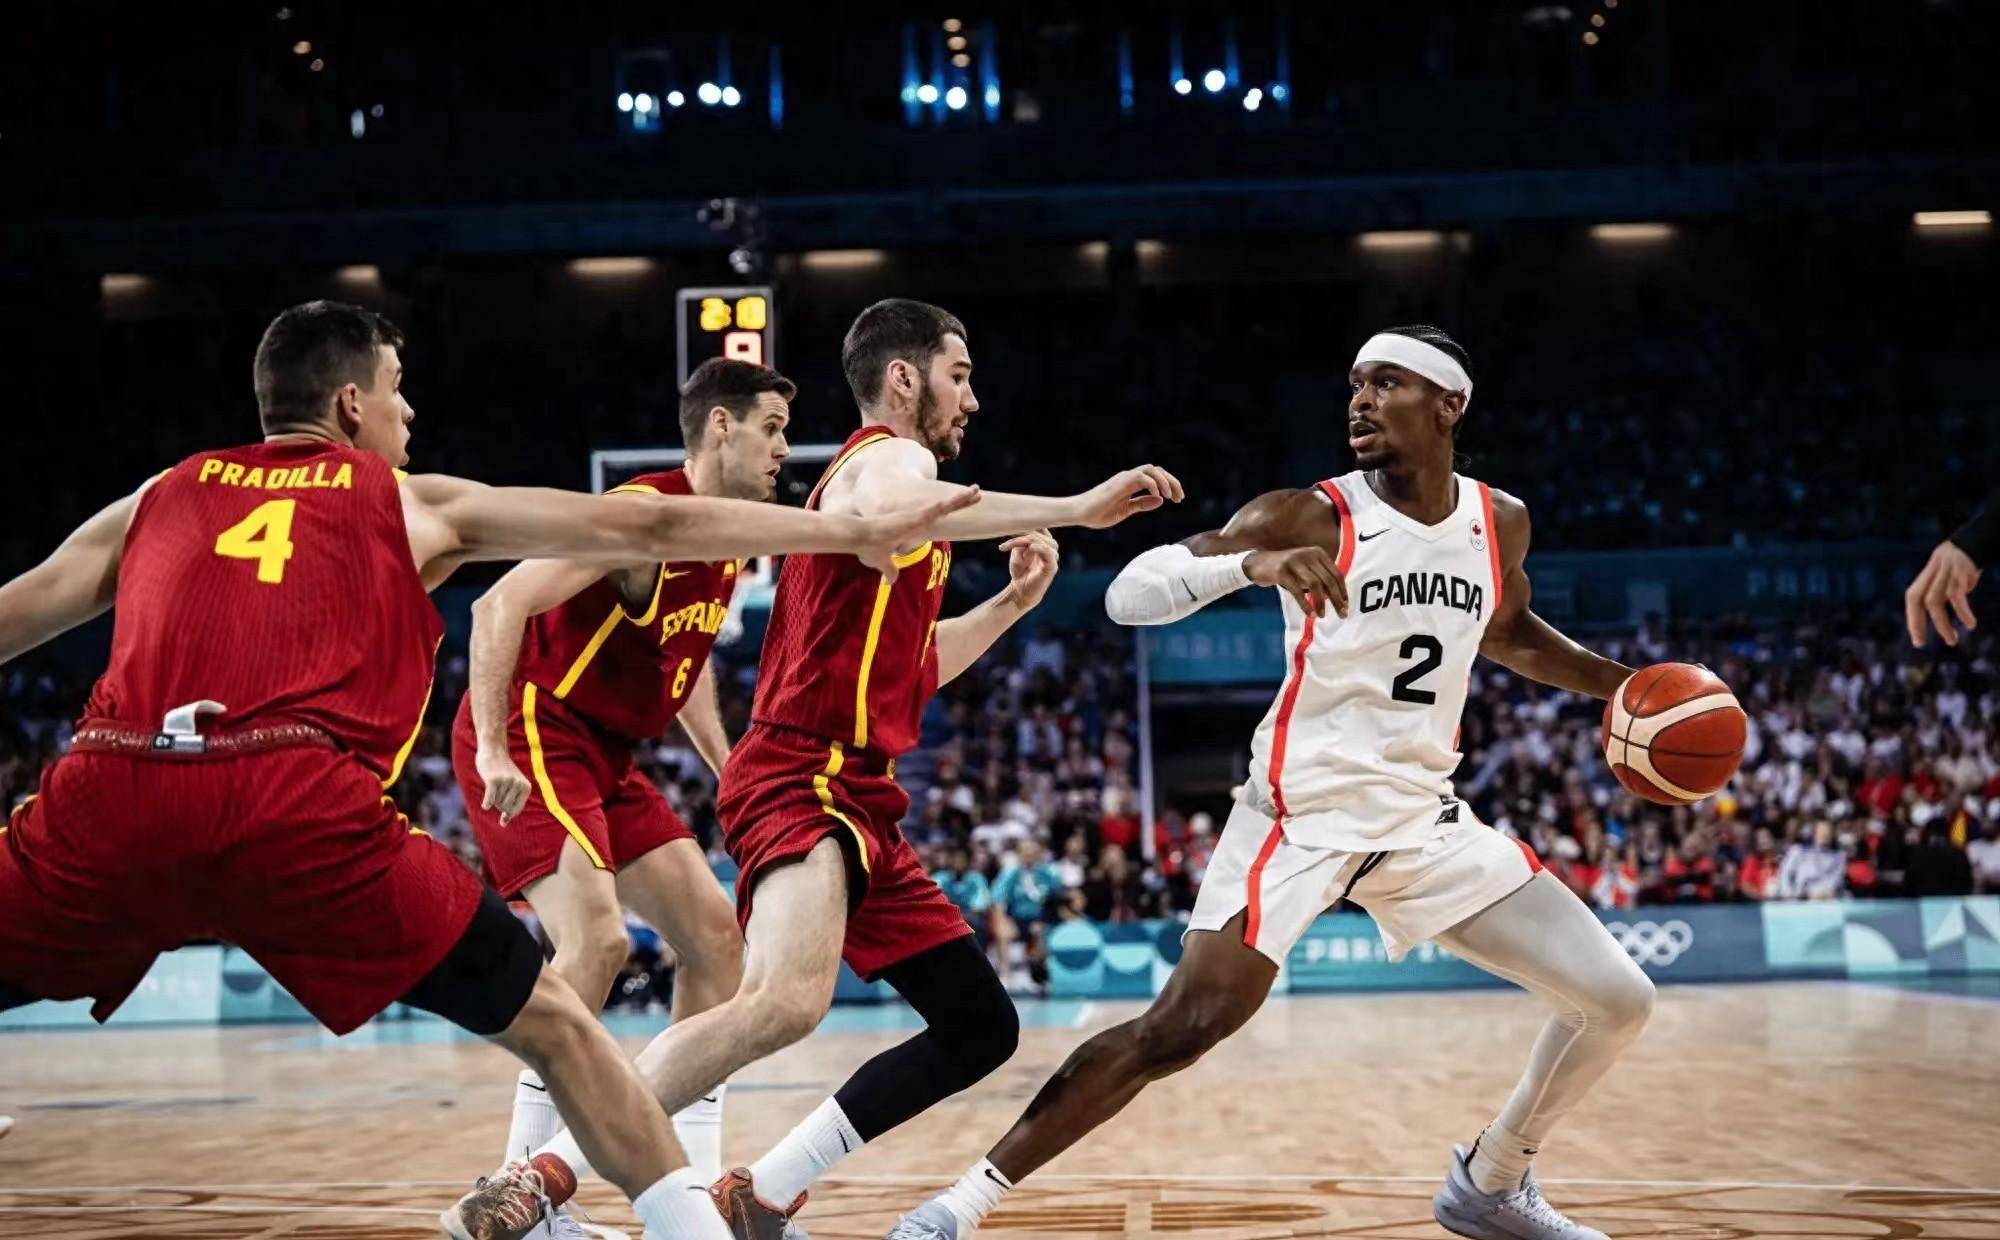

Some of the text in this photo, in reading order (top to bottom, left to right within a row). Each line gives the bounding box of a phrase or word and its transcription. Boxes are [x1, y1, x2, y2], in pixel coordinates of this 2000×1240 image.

[198, 458, 353, 490] PRADILLA
[214, 498, 296, 584] 4
[1359, 571, 1483, 622] CANADA
[671, 657, 692, 699] 6
[1391, 633, 1444, 706] 2
